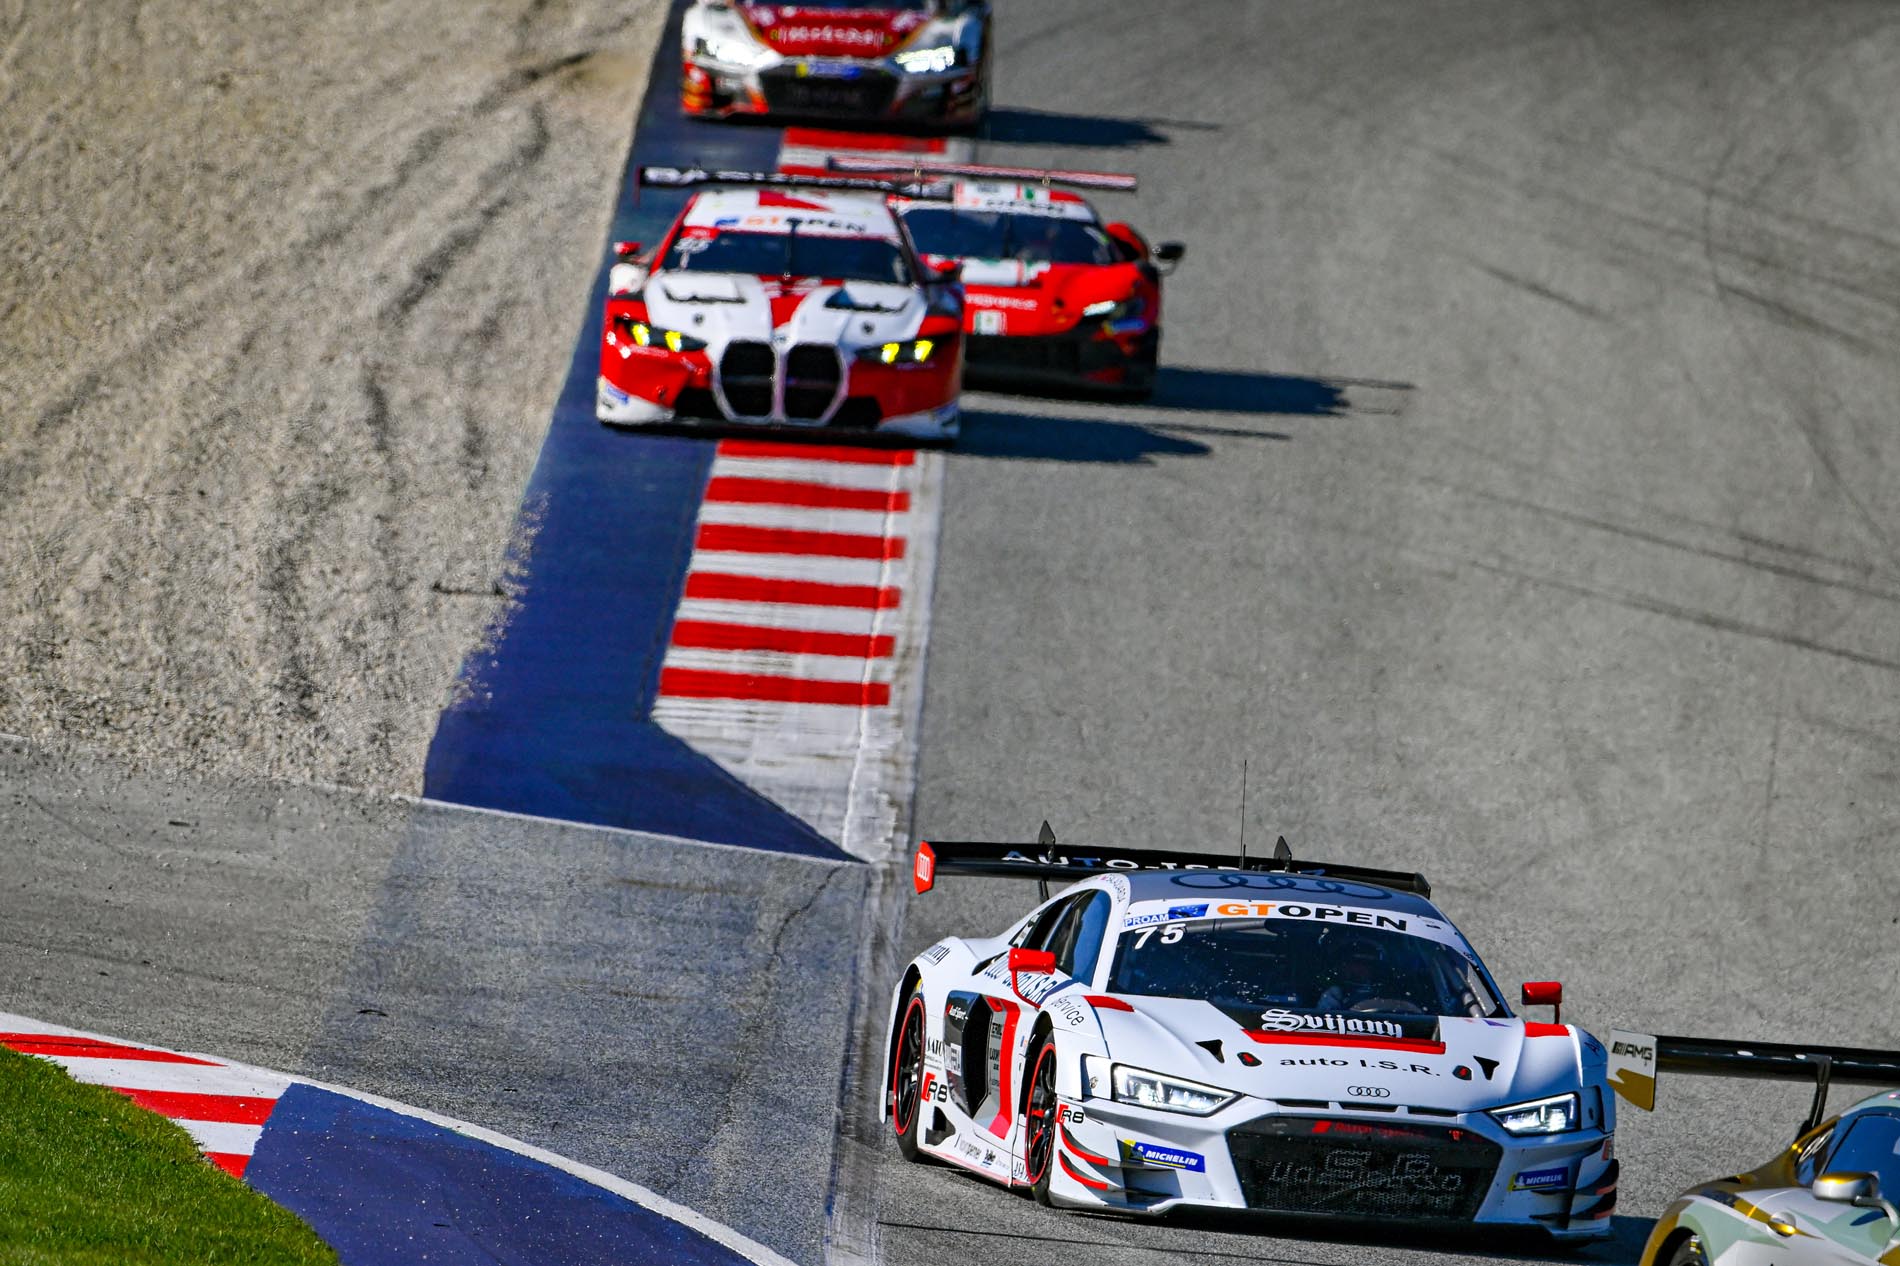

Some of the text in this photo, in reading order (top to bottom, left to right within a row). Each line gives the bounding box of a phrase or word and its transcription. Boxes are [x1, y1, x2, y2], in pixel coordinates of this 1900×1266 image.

[1125, 914, 1169, 927] PROAM
[1134, 923, 1187, 950] 75
[1261, 1008, 1402, 1039] Svijany
[1624, 1042, 1653, 1061] AMG
[1280, 1058, 1441, 1077] auto I.S.R.
[926, 1079, 947, 1103] R8
[1061, 1109, 1085, 1124] R8
[1146, 1150, 1198, 1166] MICHELIN
[1525, 1174, 1563, 1185] MICHELIN
